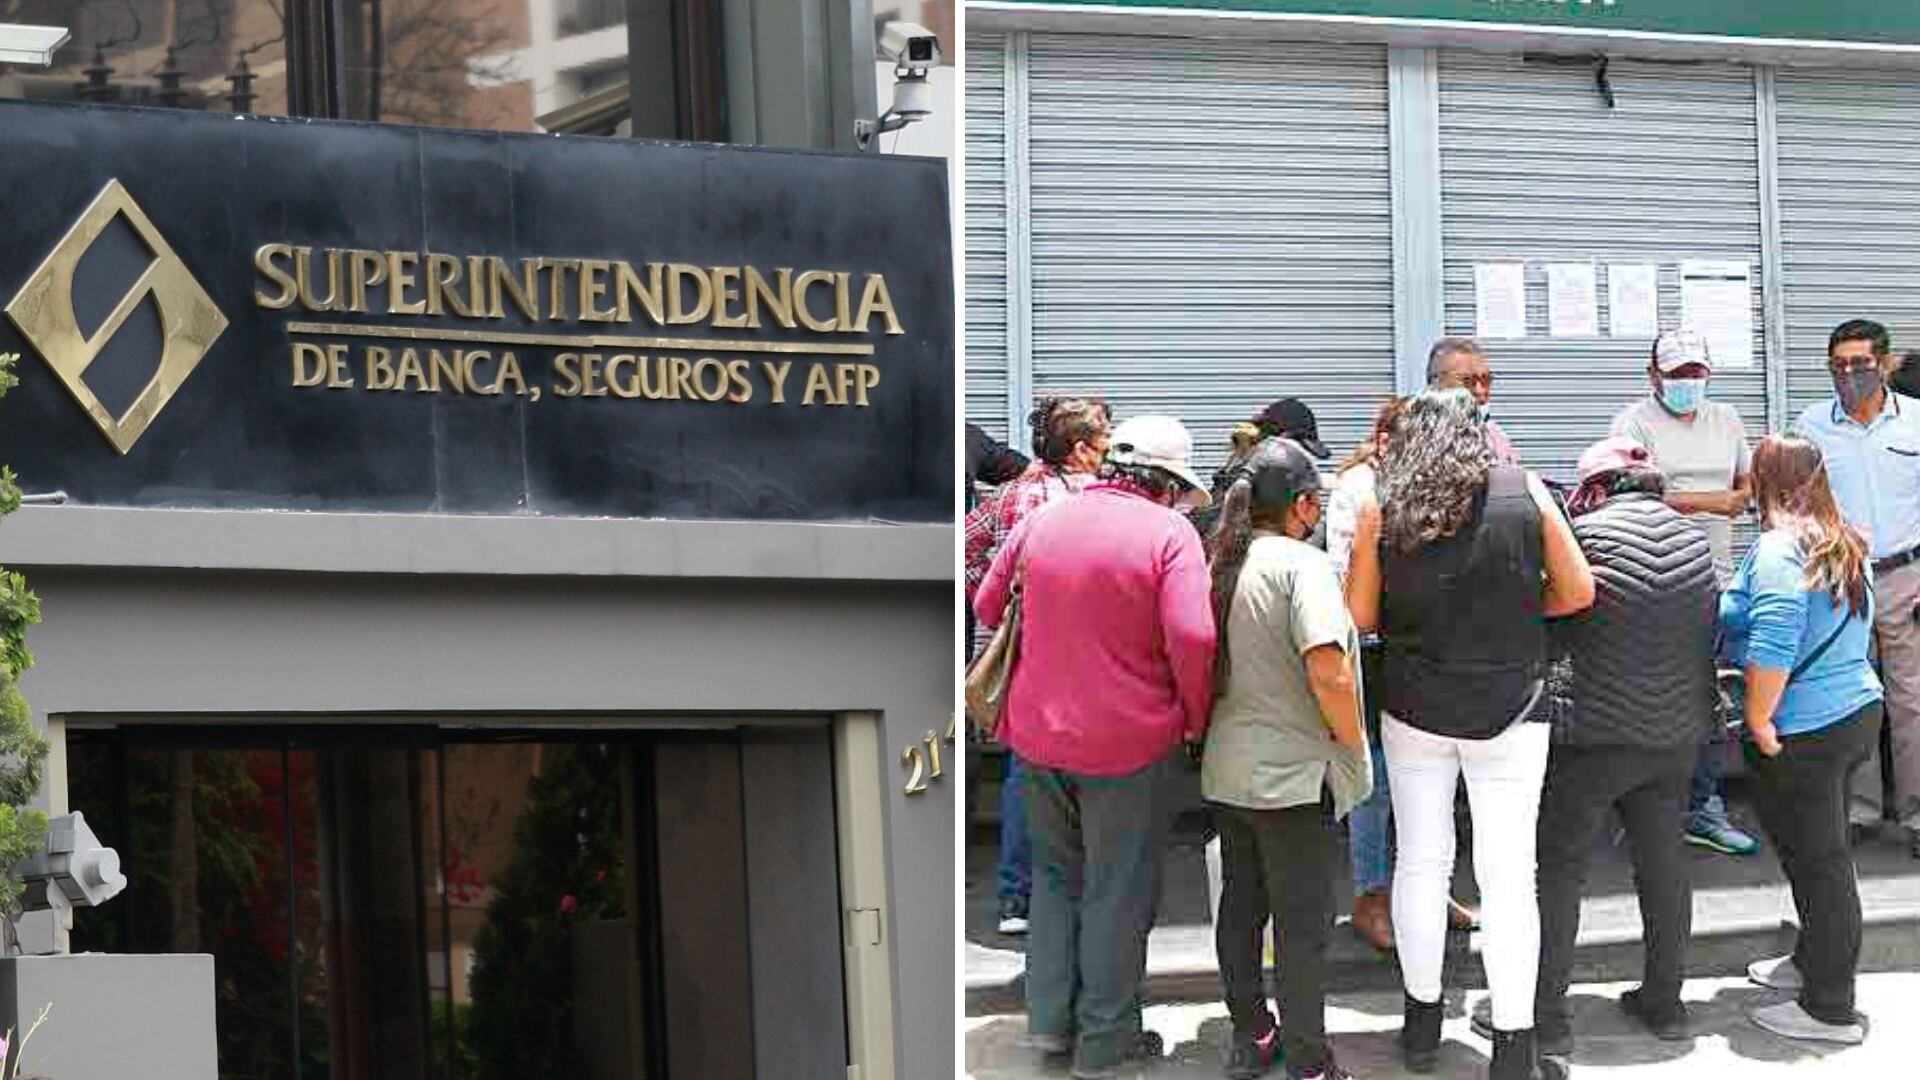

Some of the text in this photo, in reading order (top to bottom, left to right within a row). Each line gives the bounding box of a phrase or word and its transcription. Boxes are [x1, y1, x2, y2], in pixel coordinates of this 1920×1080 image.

[254, 243, 905, 335] SUPERINTENDENCIA
[292, 344, 881, 405] DE BANCA, SEGUROS Y AFP
